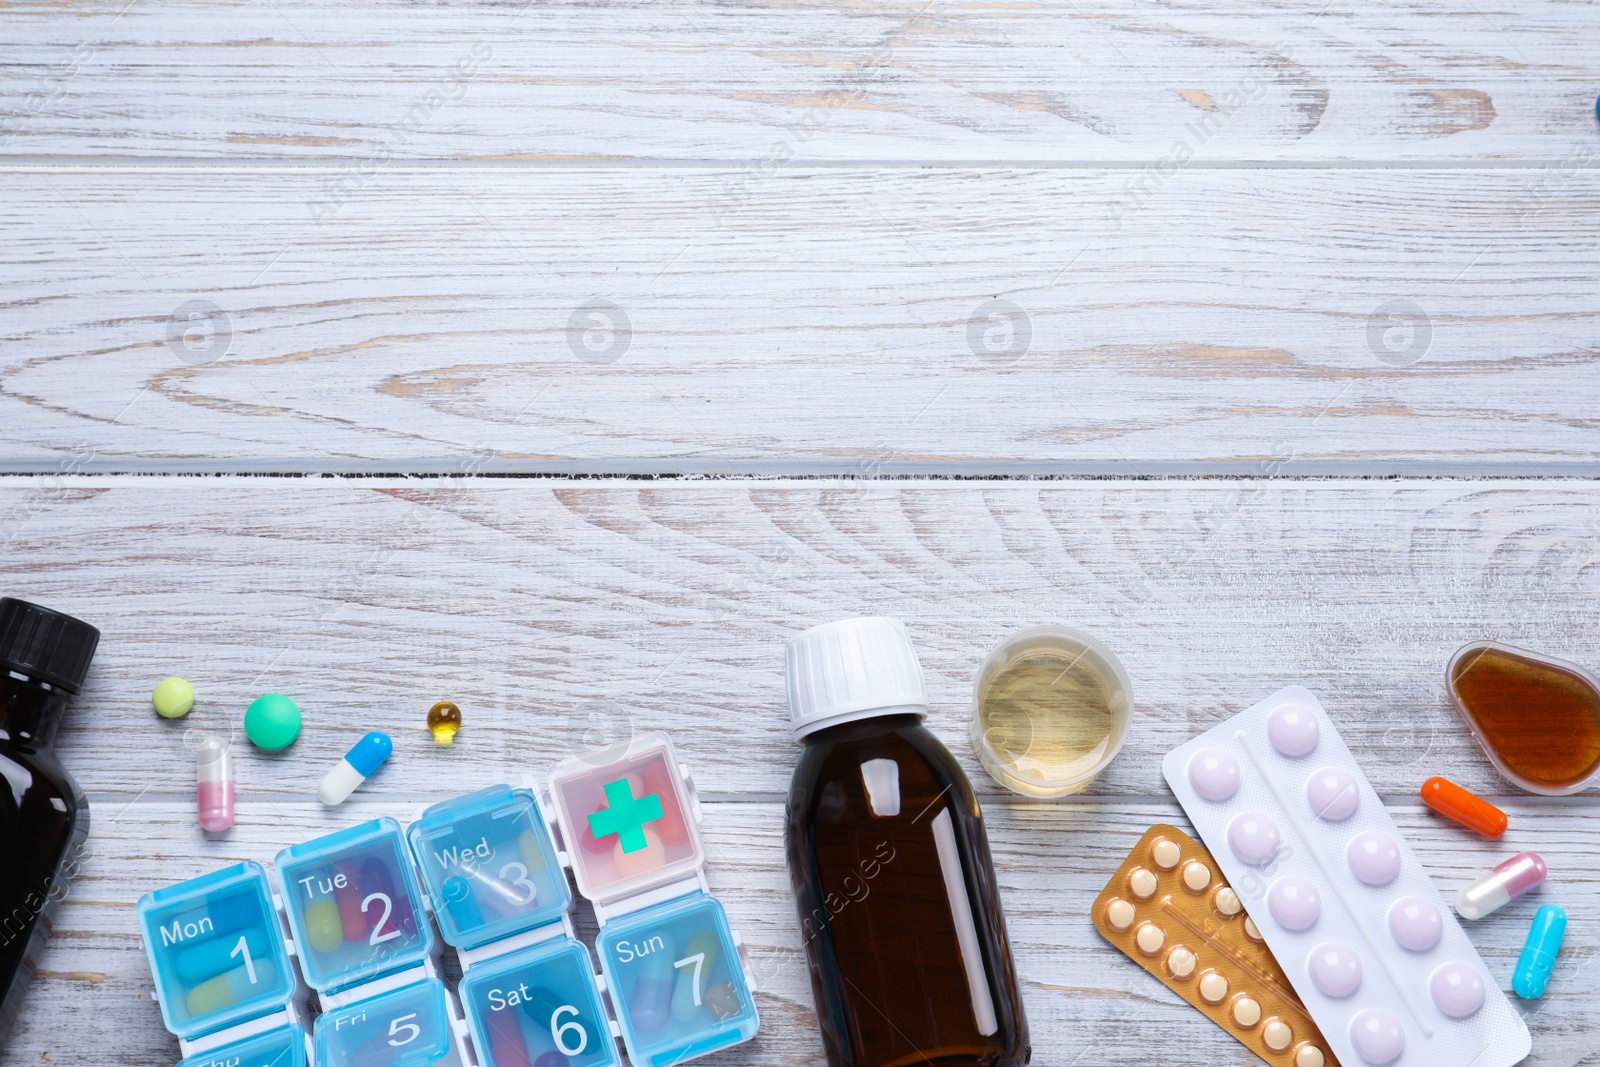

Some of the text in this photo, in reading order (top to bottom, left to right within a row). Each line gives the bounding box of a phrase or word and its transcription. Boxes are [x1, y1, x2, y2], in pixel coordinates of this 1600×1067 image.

[434, 837, 490, 870] Wed
[299, 873, 348, 900] Tue
[498, 861, 537, 907] 3
[159, 916, 214, 947] Mon
[360, 892, 402, 947] 2
[230, 935, 258, 984] 1
[616, 935, 664, 963] Sun
[673, 952, 706, 1007] 7
[487, 982, 533, 1011] Sat
[335, 1010, 367, 1031] Fri
[387, 1013, 421, 1047] 5
[550, 1004, 588, 1056] 6
